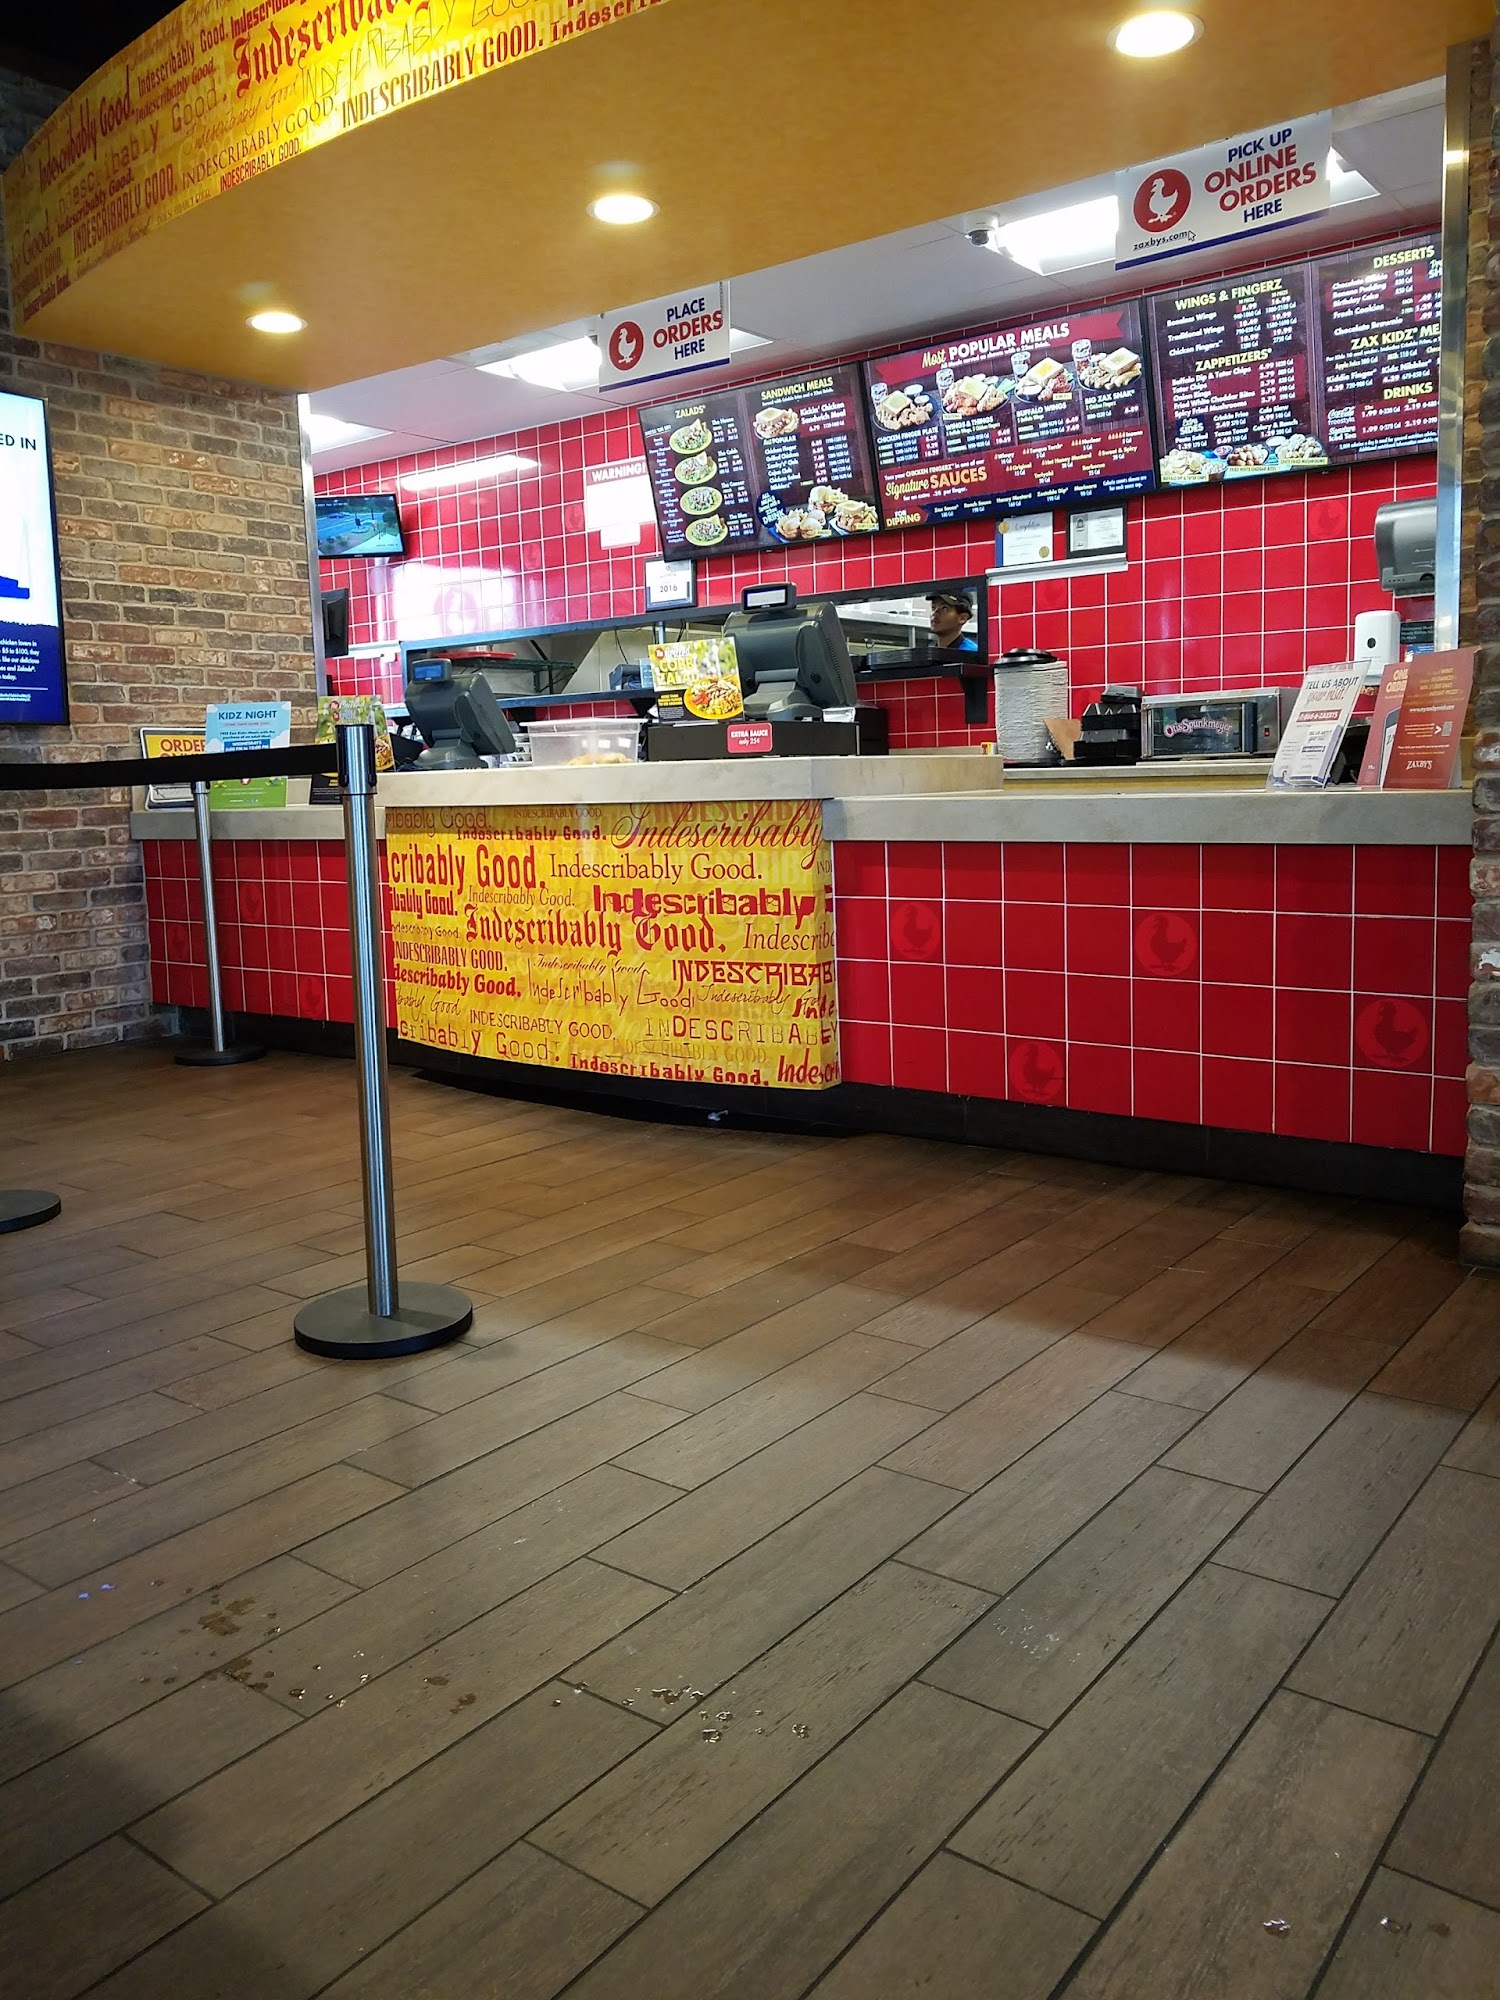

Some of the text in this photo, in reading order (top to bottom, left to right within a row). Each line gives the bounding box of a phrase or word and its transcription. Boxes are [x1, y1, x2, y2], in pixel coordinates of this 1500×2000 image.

[199, 16, 229, 53] Good.
[343, 19, 544, 128] INDESCRIBABLY GOOD.
[285, 96, 338, 133] GOOD.
[278, 137, 303, 162] GOOD.
[1228, 127, 1292, 163] PICK UP
[1204, 143, 1297, 193] ONLINE
[1218, 162, 1317, 212] ORDERS
[1243, 198, 1283, 223] HERE
[1133, 229, 1189, 251] zaxbys.com
[1373, 244, 1436, 269] DESSERTS
[1174, 278, 1283, 311] WINGS & FINGERZ
[666, 297, 706, 322] PLACE
[653, 309, 724, 348] ORDERS
[1333, 323, 1371, 336] Chocolate
[674, 338, 706, 360] HERE
[921, 323, 1071, 369] Most POPULAR MEALS
[1350, 334, 1380, 350] ZAX
[761, 377, 834, 401] SANDWICH MEALS
[1383, 381, 1434, 400] DRINKS
[1361, 403, 1422, 418] 1.99 2.19
[1179, 422, 1204, 436] SIDES
[1361, 419, 1422, 433] 1.99 2.19
[20, 437, 37, 451] IN
[591, 461, 646, 483] WARNING!
[884, 465, 988, 500] Signature SAUCES
[885, 513, 921, 528] DIPPING
[660, 585, 678, 593] 2016
[1305, 676, 1360, 690] TELL US ABOUT
[218, 710, 278, 720] KIDZ NIGHT
[730, 728, 769, 738] EXTRA SAUCE
[738, 738, 750, 747] only
[1164, 722, 1184, 738] Otis
[1405, 760, 1433, 771] ZAXBY'S
[439, 806, 492, 829] Good.
[514, 807, 604, 818] INDESCRIBABLY GOOD.
[457, 825, 607, 841] Indescribably Good.
[610, 800, 824, 871] Indescribably
[390, 843, 543, 896] cribably Good.
[548, 852, 764, 885] Indescribably Good.
[425, 889, 458, 917] Good.
[469, 884, 575, 912] Indescribably Good.
[593, 884, 817, 931] Indescribably
[463, 903, 727, 957] Indescribably Good.
[470, 947, 508, 972] GOOD.
[533, 952, 607, 978] Indescribably
[473, 973, 522, 998] Good.
[470, 1008, 616, 1042] INDESCRIBABLY GOOD.
[645, 1017, 838, 1048] INDESCRIBABLY
[399, 1020, 561, 1063] cribably Good.
[570, 1054, 769, 1087] Indescribably Good.
